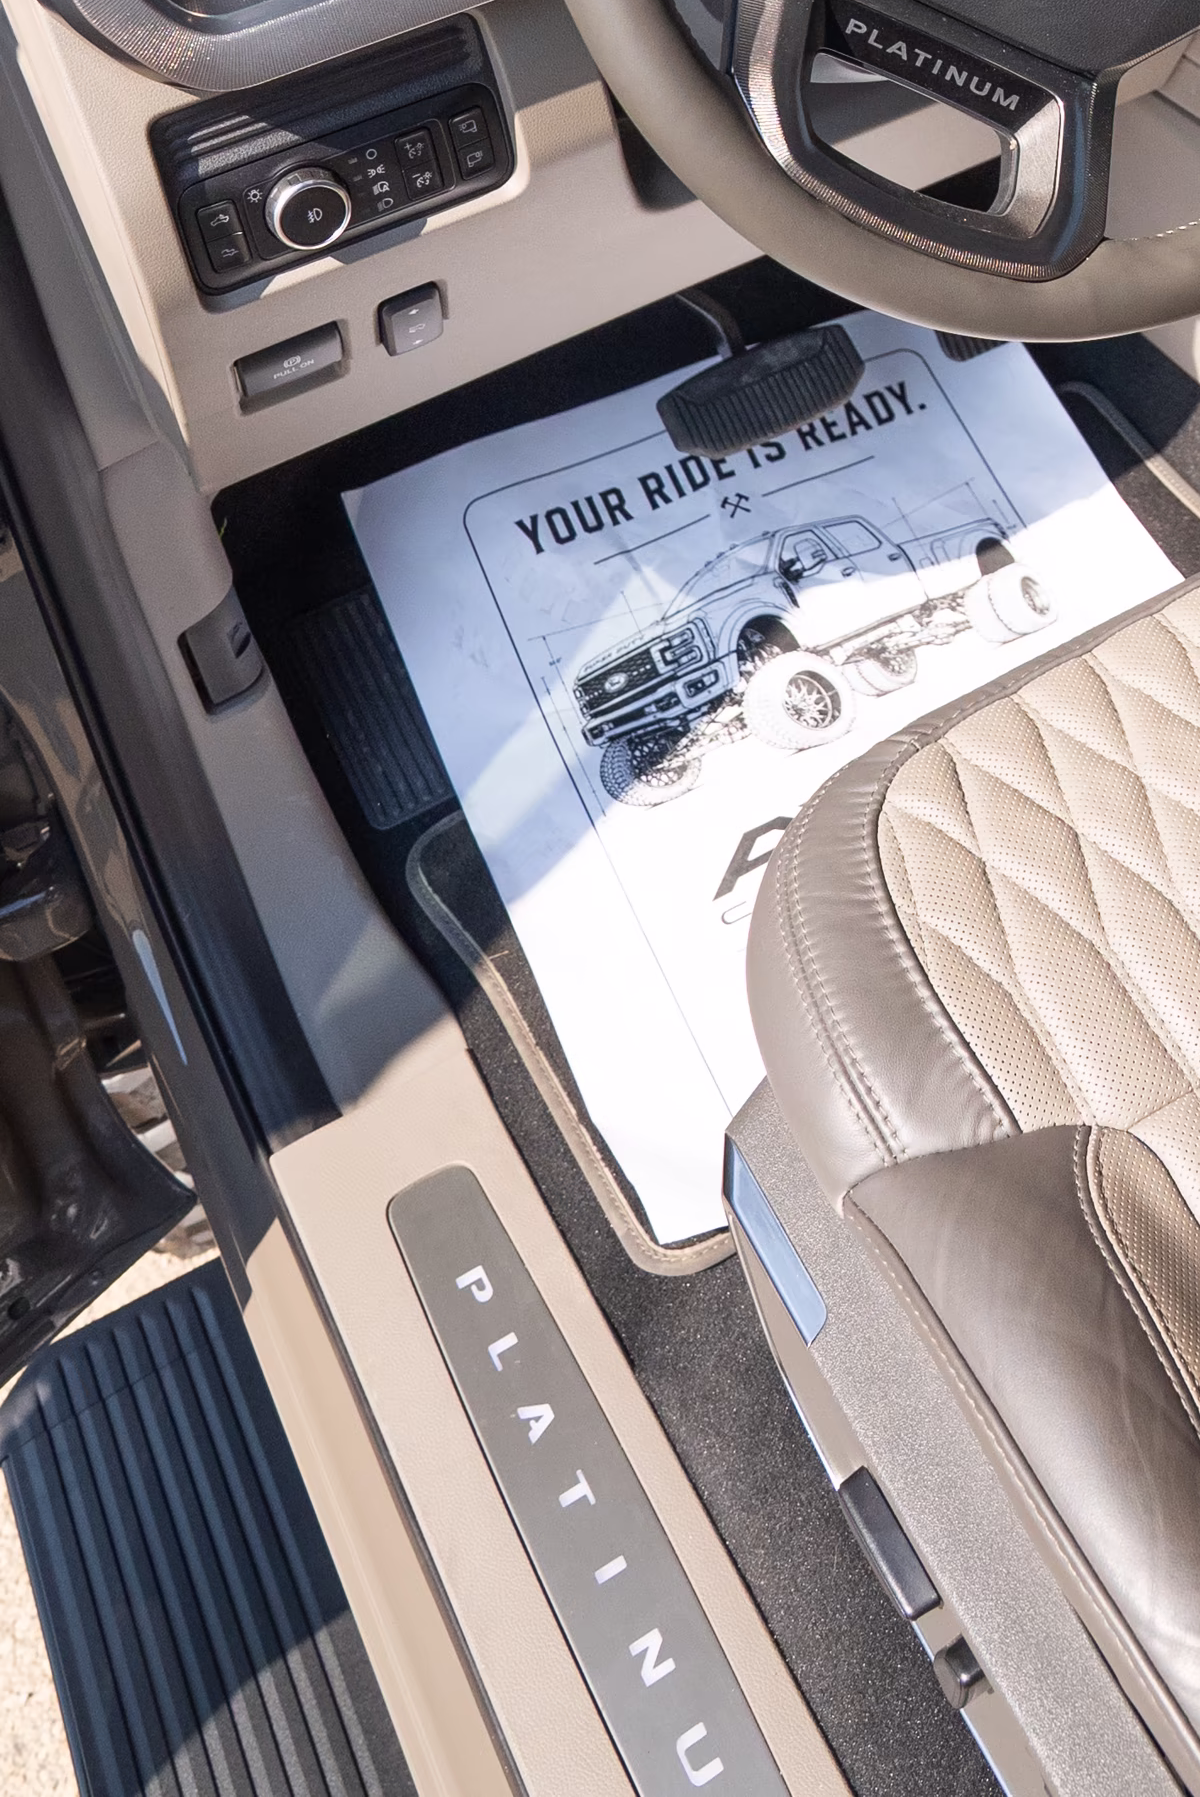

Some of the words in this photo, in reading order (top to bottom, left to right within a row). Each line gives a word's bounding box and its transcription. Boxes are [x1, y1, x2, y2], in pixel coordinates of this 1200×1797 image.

[845, 18, 1020, 111] PLATINUM
[273, 366, 299, 380] PULL
[300, 359, 315, 369] ON
[514, 486, 634, 554] YOUR
[638, 455, 736, 511] RIDE
[750, 441, 787, 469] IS
[796, 381, 927, 452] READY.
